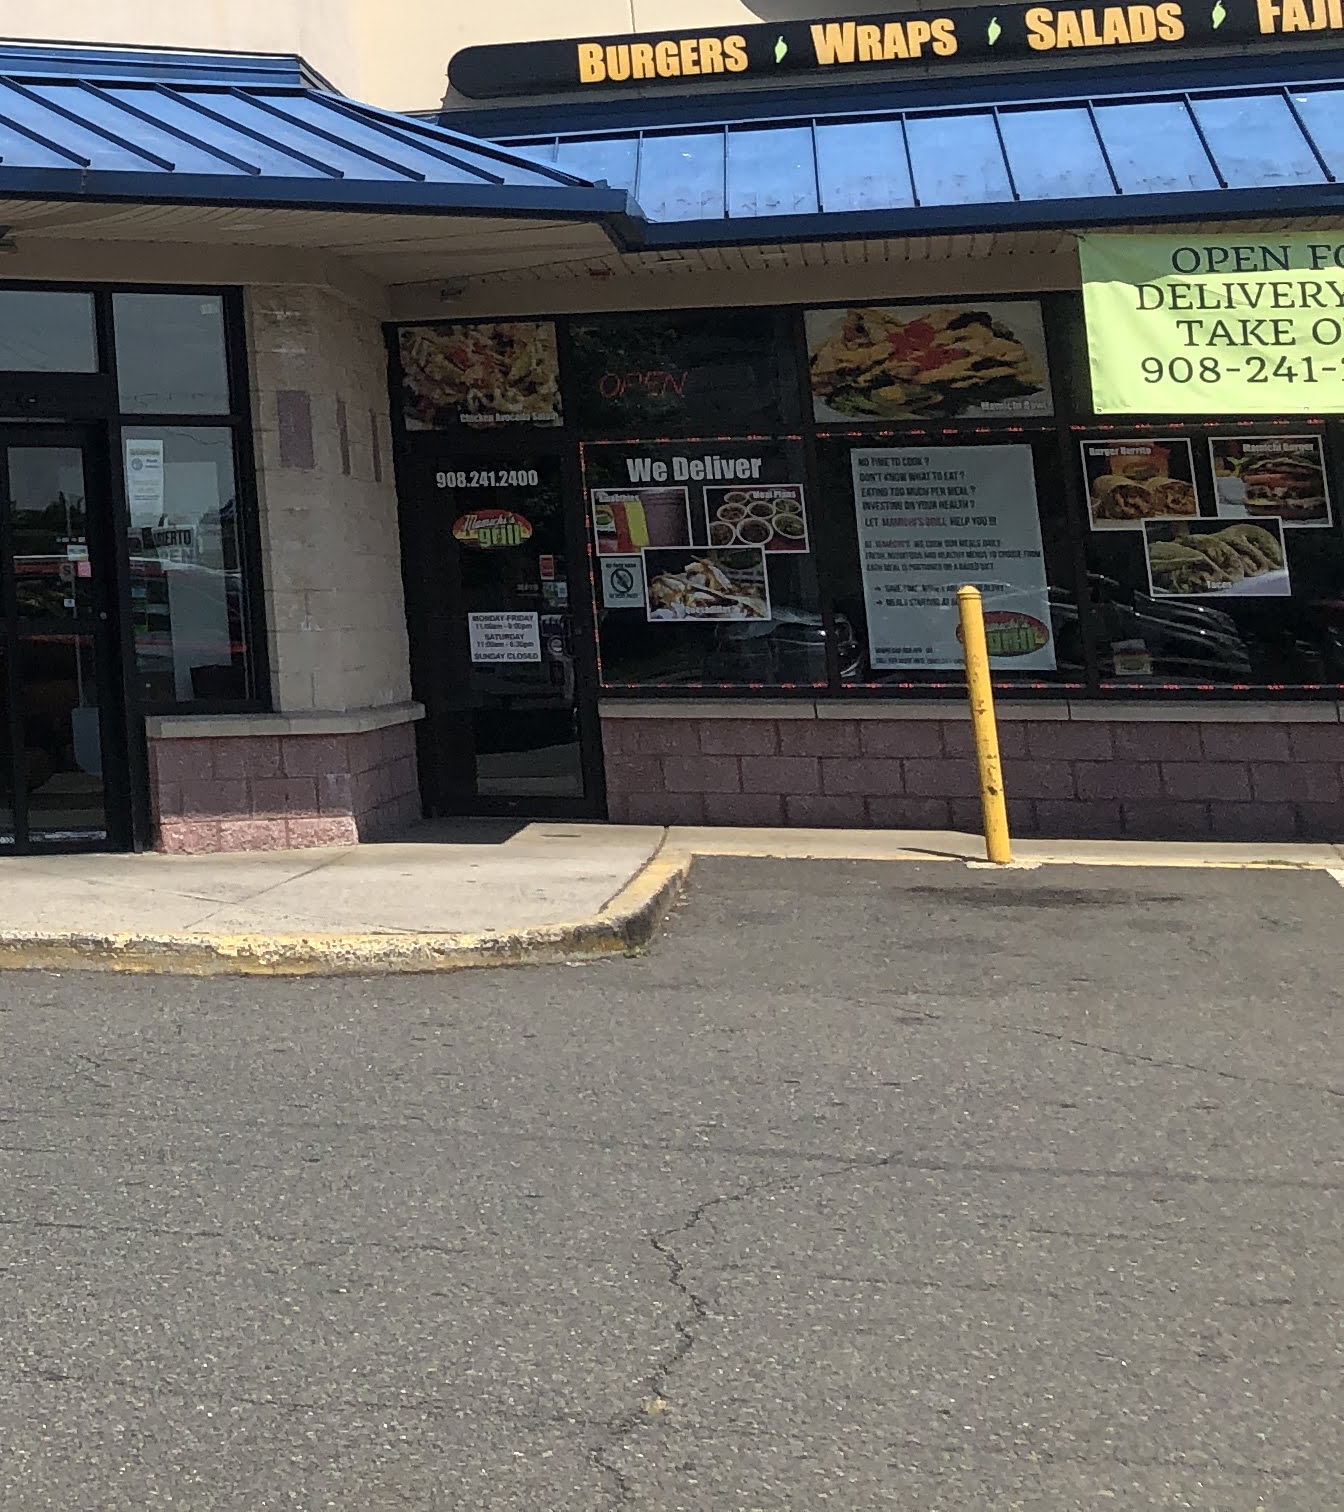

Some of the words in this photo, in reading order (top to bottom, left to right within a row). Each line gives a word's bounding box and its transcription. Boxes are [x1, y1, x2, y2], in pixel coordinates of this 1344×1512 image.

[578, 34, 749, 84] BURGERS
[810, 18, 958, 66] WRAPS
[1025, 2, 1185, 50] SALADS
[1172, 245, 1292, 274] OPEN
[1177, 318, 1297, 347] TAKE
[1141, 354, 1344, 385] 908-241-
[598, 370, 689, 398] OPEN
[436, 469, 540, 489] 908.241.2400
[626, 457, 668, 482] We
[672, 455, 763, 481] Deliver
[479, 524, 521, 549] grill
